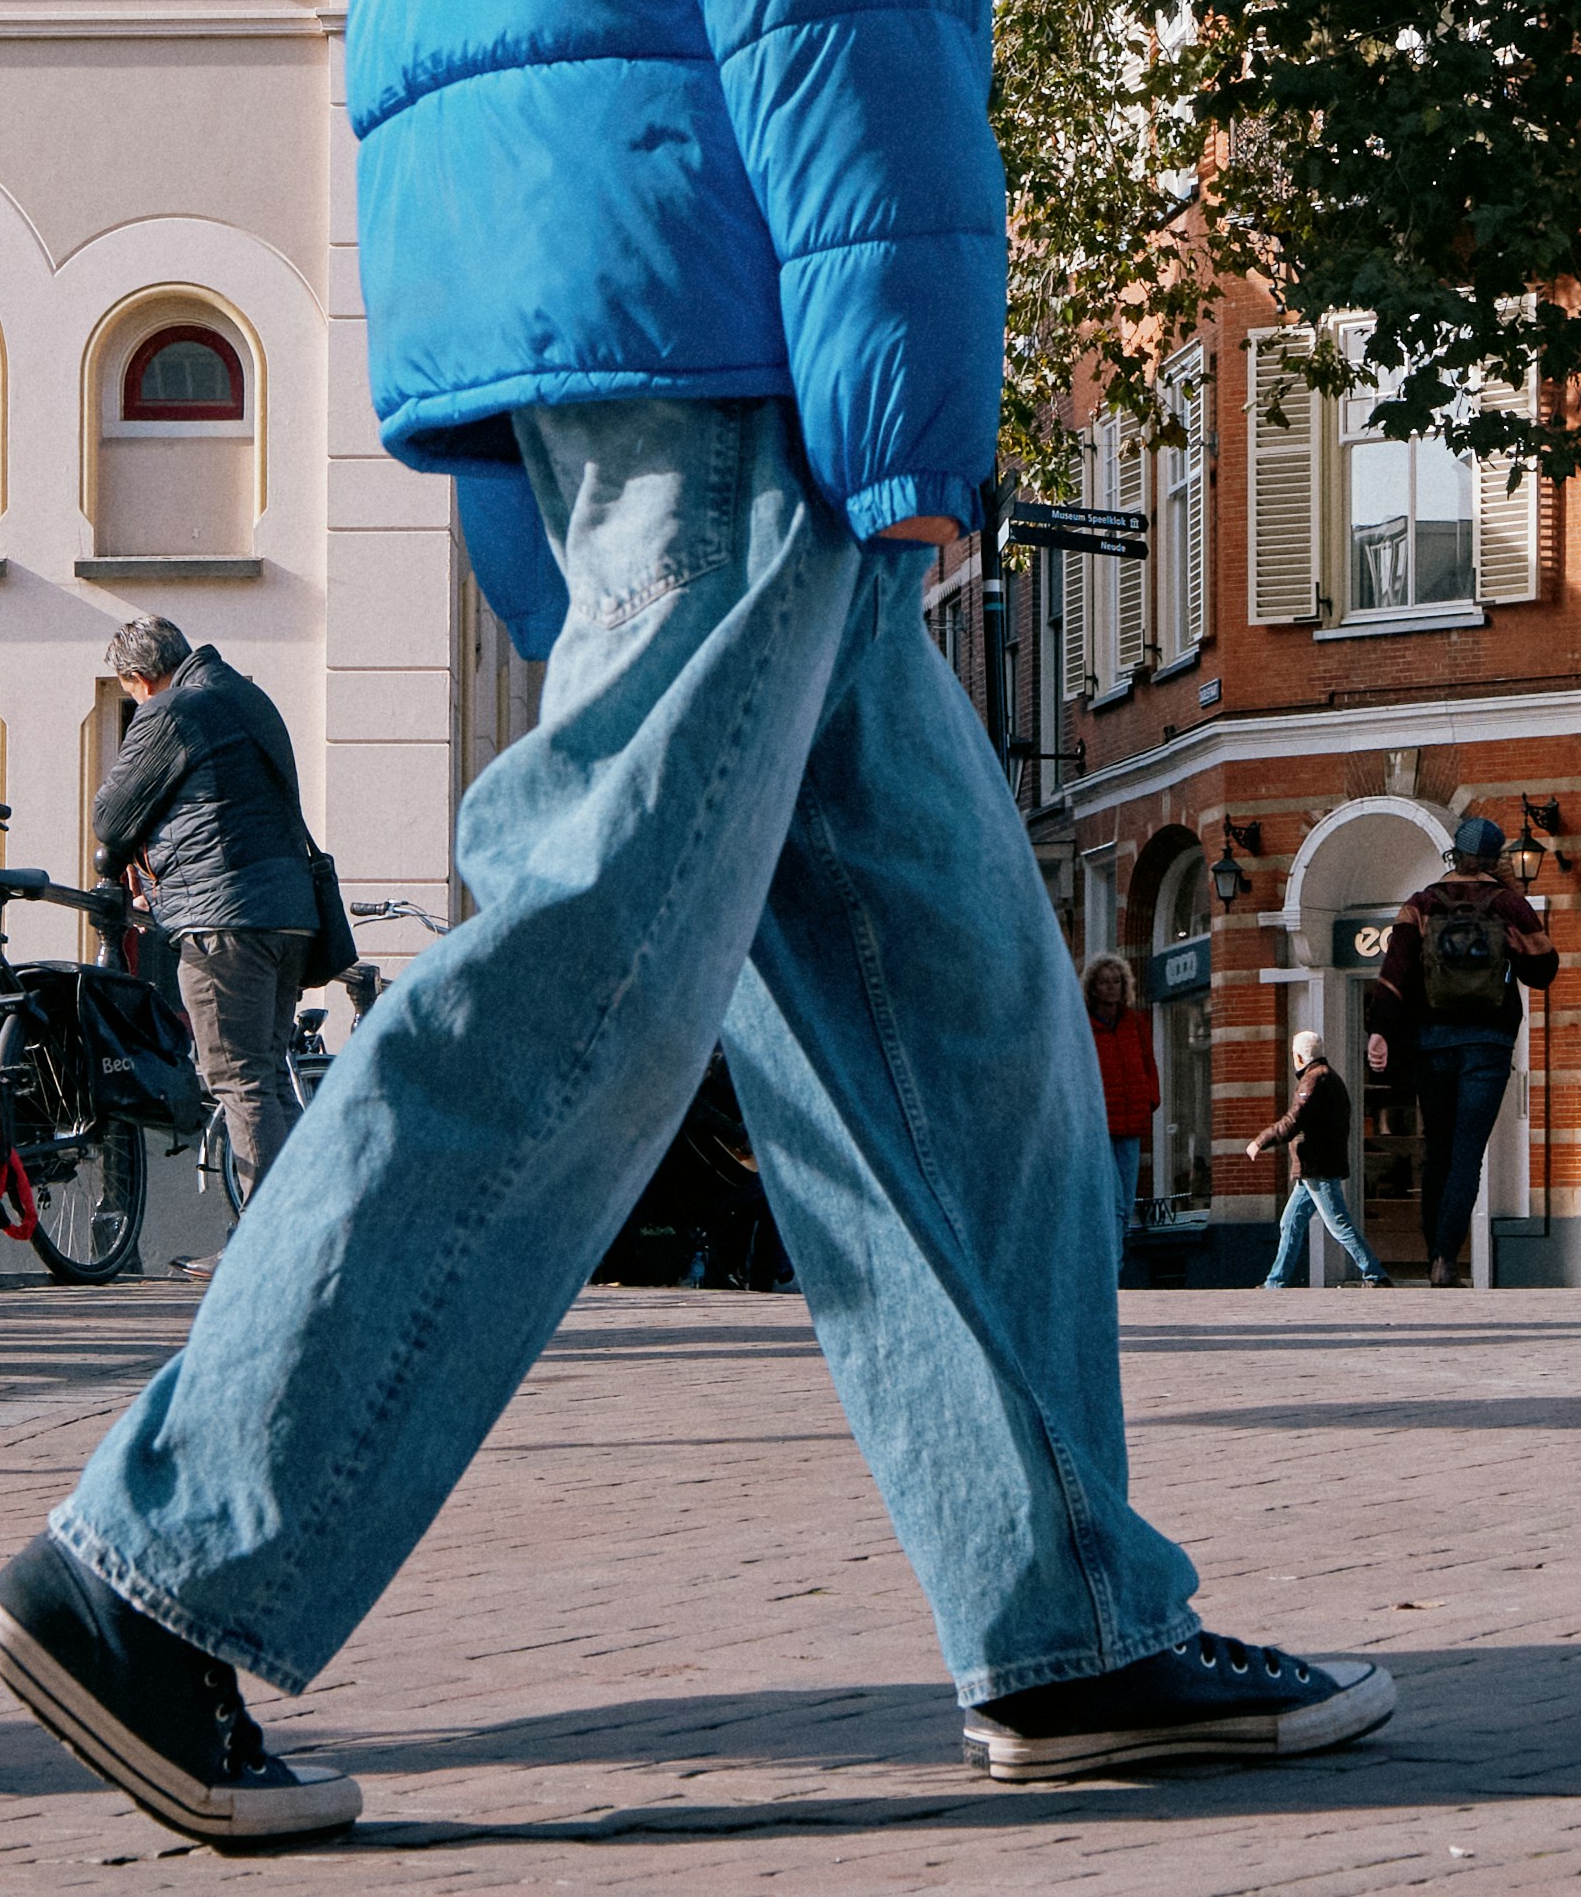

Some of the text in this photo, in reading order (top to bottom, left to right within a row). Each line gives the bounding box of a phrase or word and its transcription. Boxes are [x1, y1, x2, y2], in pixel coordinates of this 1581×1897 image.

[1051, 510, 1126, 526] Museum Speelklok
[1100, 541, 1126, 552] Neude
[1166, 951, 1197, 985] ecco
